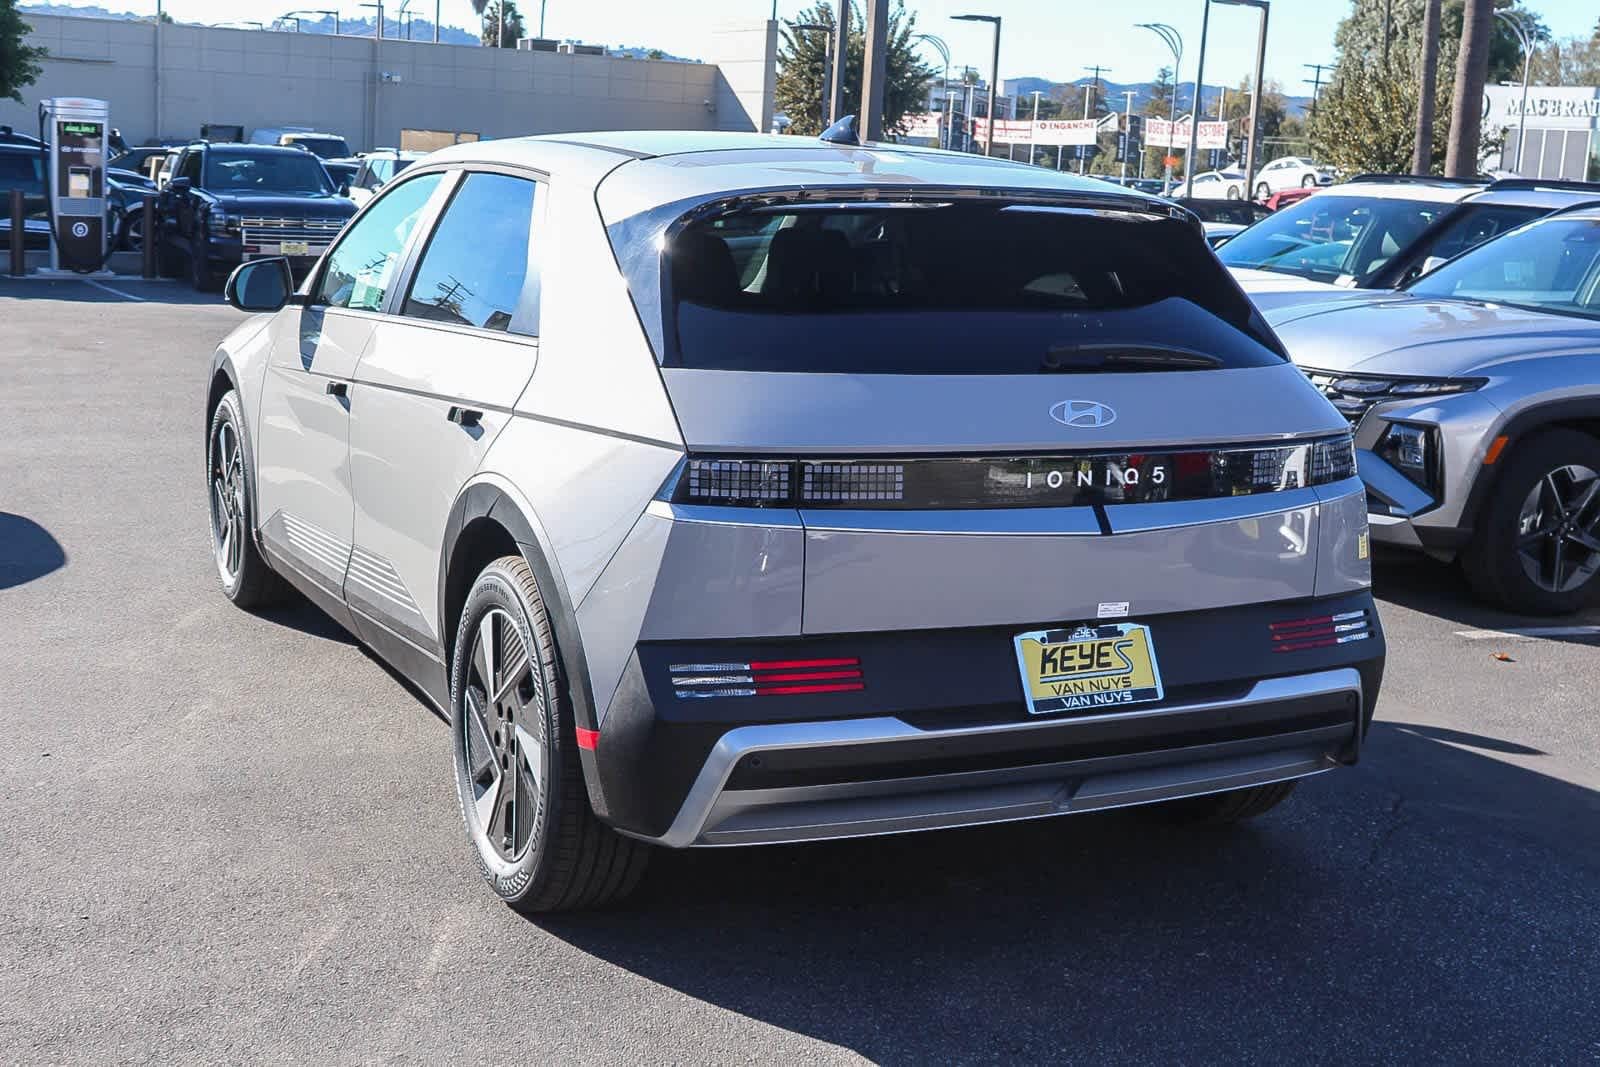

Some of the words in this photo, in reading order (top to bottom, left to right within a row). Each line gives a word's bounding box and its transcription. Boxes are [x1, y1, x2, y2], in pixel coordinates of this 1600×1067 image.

[1026, 468, 1139, 489] IONIQ
[1151, 466, 1165, 484] 5
[1040, 640, 1133, 678] KEYES
[1051, 682, 1084, 696] VAN
[1089, 676, 1132, 692] NUYS
[1062, 695, 1090, 708] VAN
[1094, 691, 1133, 705] NUYS
